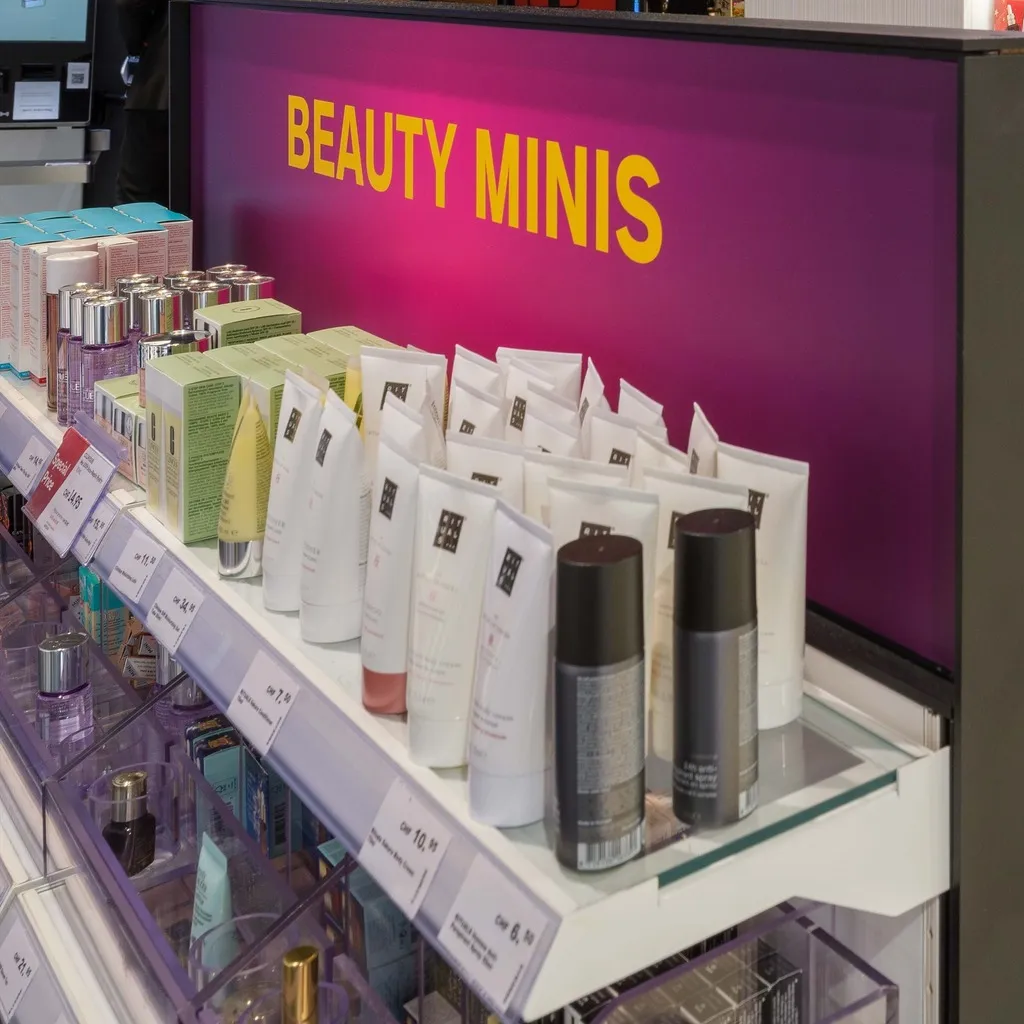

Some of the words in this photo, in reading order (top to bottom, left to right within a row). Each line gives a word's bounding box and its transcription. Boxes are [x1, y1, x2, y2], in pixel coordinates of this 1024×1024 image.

[287, 94, 458, 209] BEAUTY
[475, 128, 663, 264] MINIS
[52, 452, 72, 477] Special
[611, 452, 629, 464] RIT
[41, 470, 55, 491] Price
[441, 513, 464, 528] RIT
[439, 526, 460, 540] UAL
[172, 595, 181, 606] CHF
[266, 684, 276, 697] CHF
[400, 821, 412, 836] CHF
[494, 913, 509, 932] CHF
